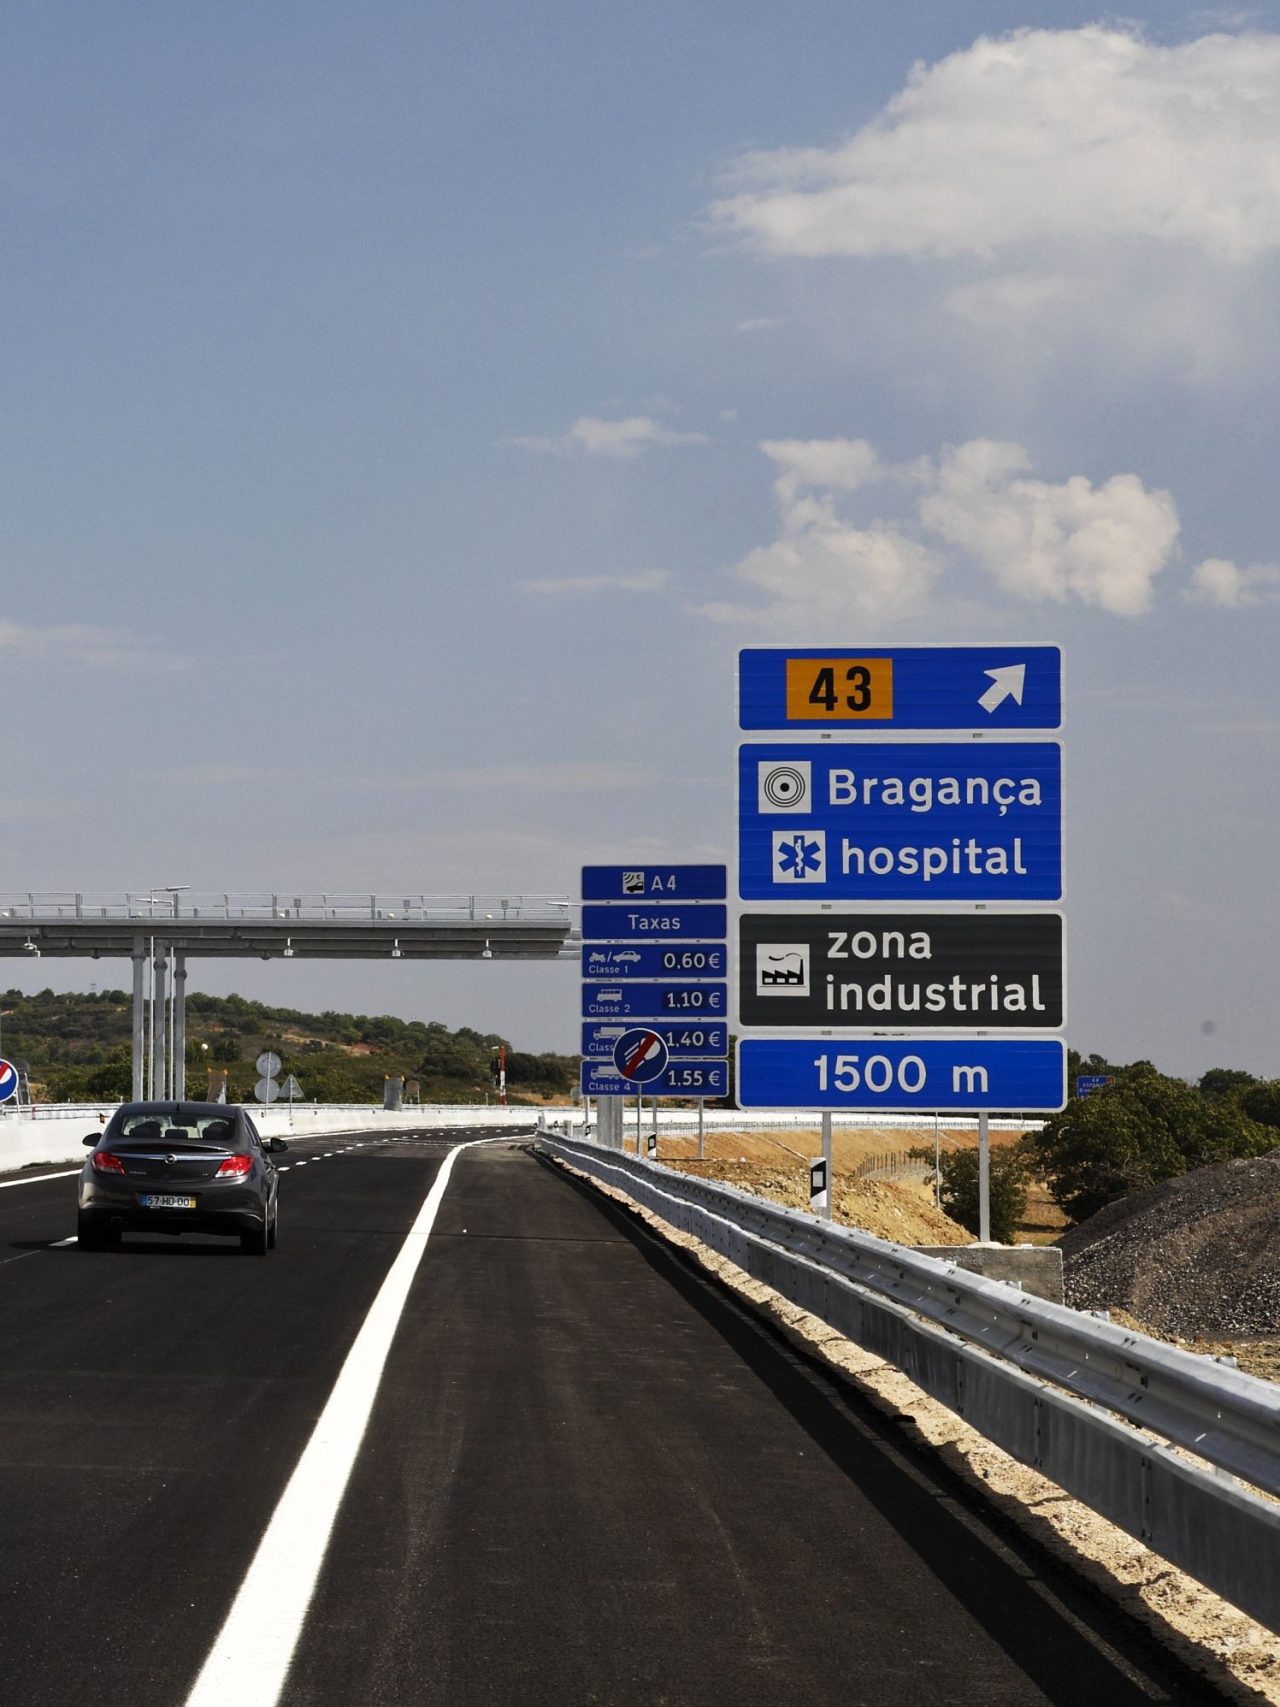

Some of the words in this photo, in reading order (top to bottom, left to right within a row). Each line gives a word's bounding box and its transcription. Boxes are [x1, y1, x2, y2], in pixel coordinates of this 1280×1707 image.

[808, 665, 872, 712] 43
[828, 768, 1042, 817] Bragança
[841, 837, 1027, 882] hospital
[627, 914, 681, 930] Taxas
[827, 930, 933, 960] zona
[588, 965, 620, 974] Classe
[663, 952, 706, 970] 0,60
[667, 991, 703, 1009] 1,10
[708, 992, 721, 1008] €
[826, 973, 1046, 1012] industrial
[588, 1004, 620, 1013] Classe
[624, 1004, 631, 1013] 2
[666, 1031, 704, 1048] 1,40
[708, 1031, 720, 1047] €
[668, 1070, 703, 1088] 1,55
[708, 1070, 721, 1086] €
[813, 1054, 927, 1093] 1500
[952, 1065, 989, 1093] m
[588, 1082, 620, 1091] Classe
[623, 1082, 631, 1091] 4
